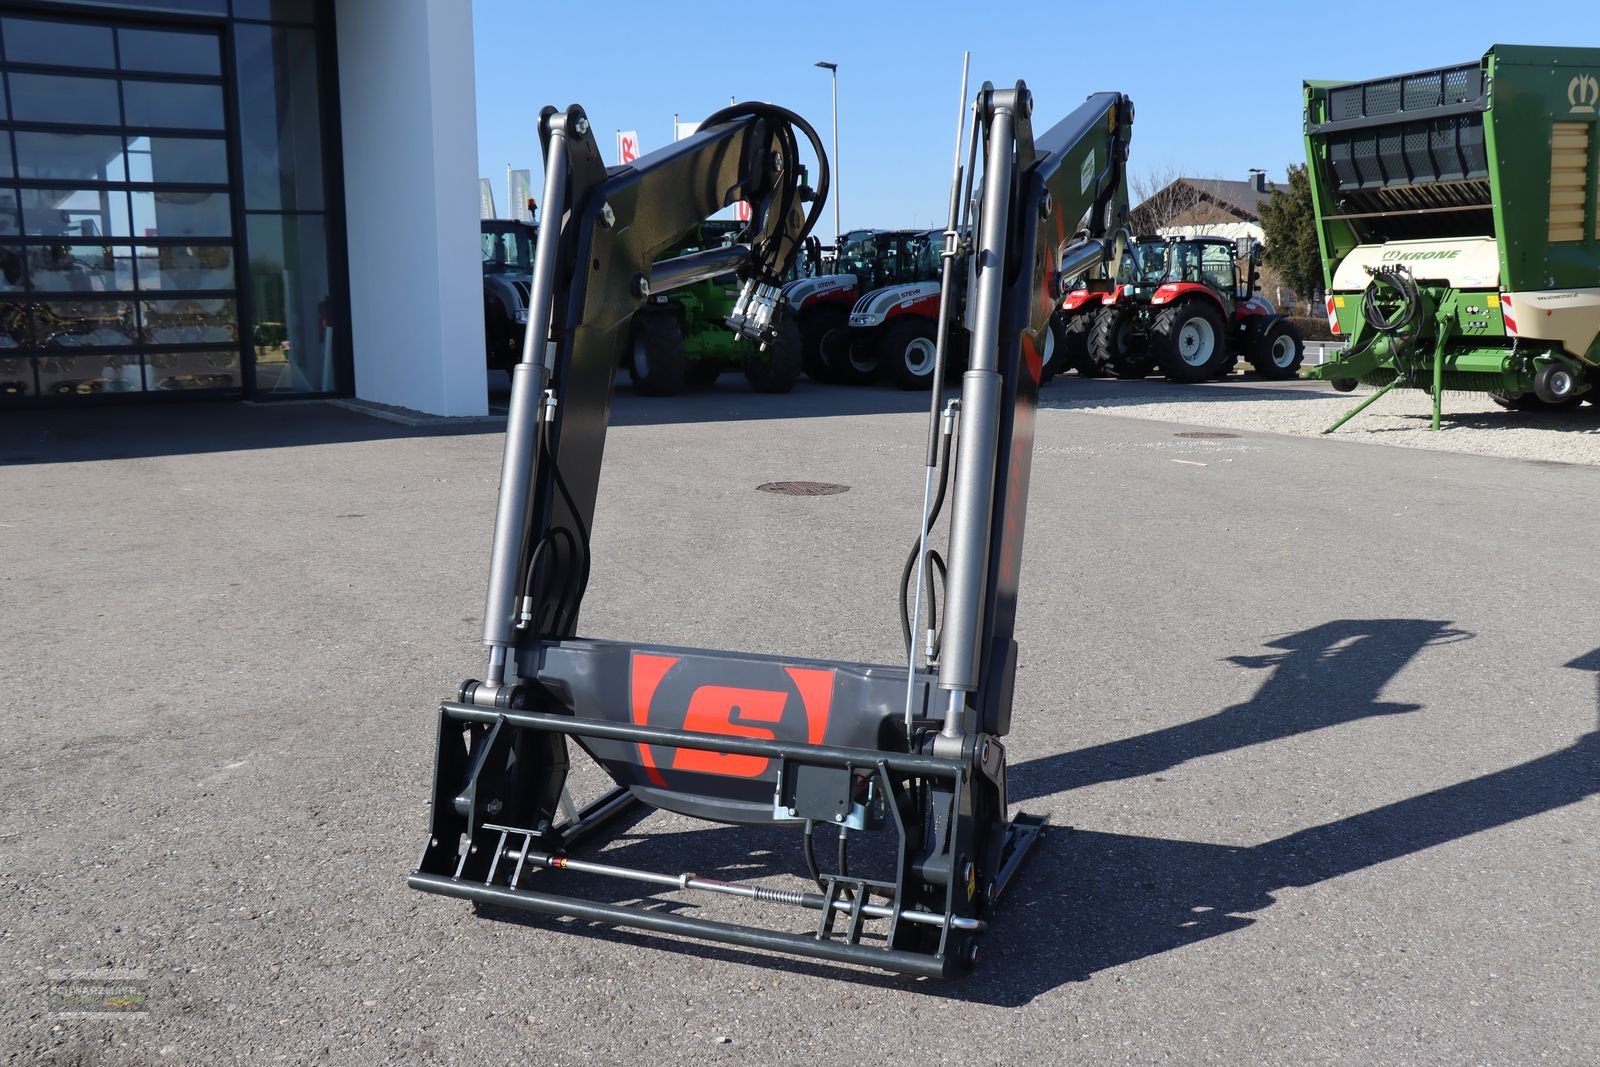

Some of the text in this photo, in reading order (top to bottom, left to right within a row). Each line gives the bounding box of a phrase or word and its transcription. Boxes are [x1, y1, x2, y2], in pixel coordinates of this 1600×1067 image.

[1398, 250, 1462, 261] KRONE
[817, 280, 836, 288] STEYR
[900, 289, 921, 299] STEYR
